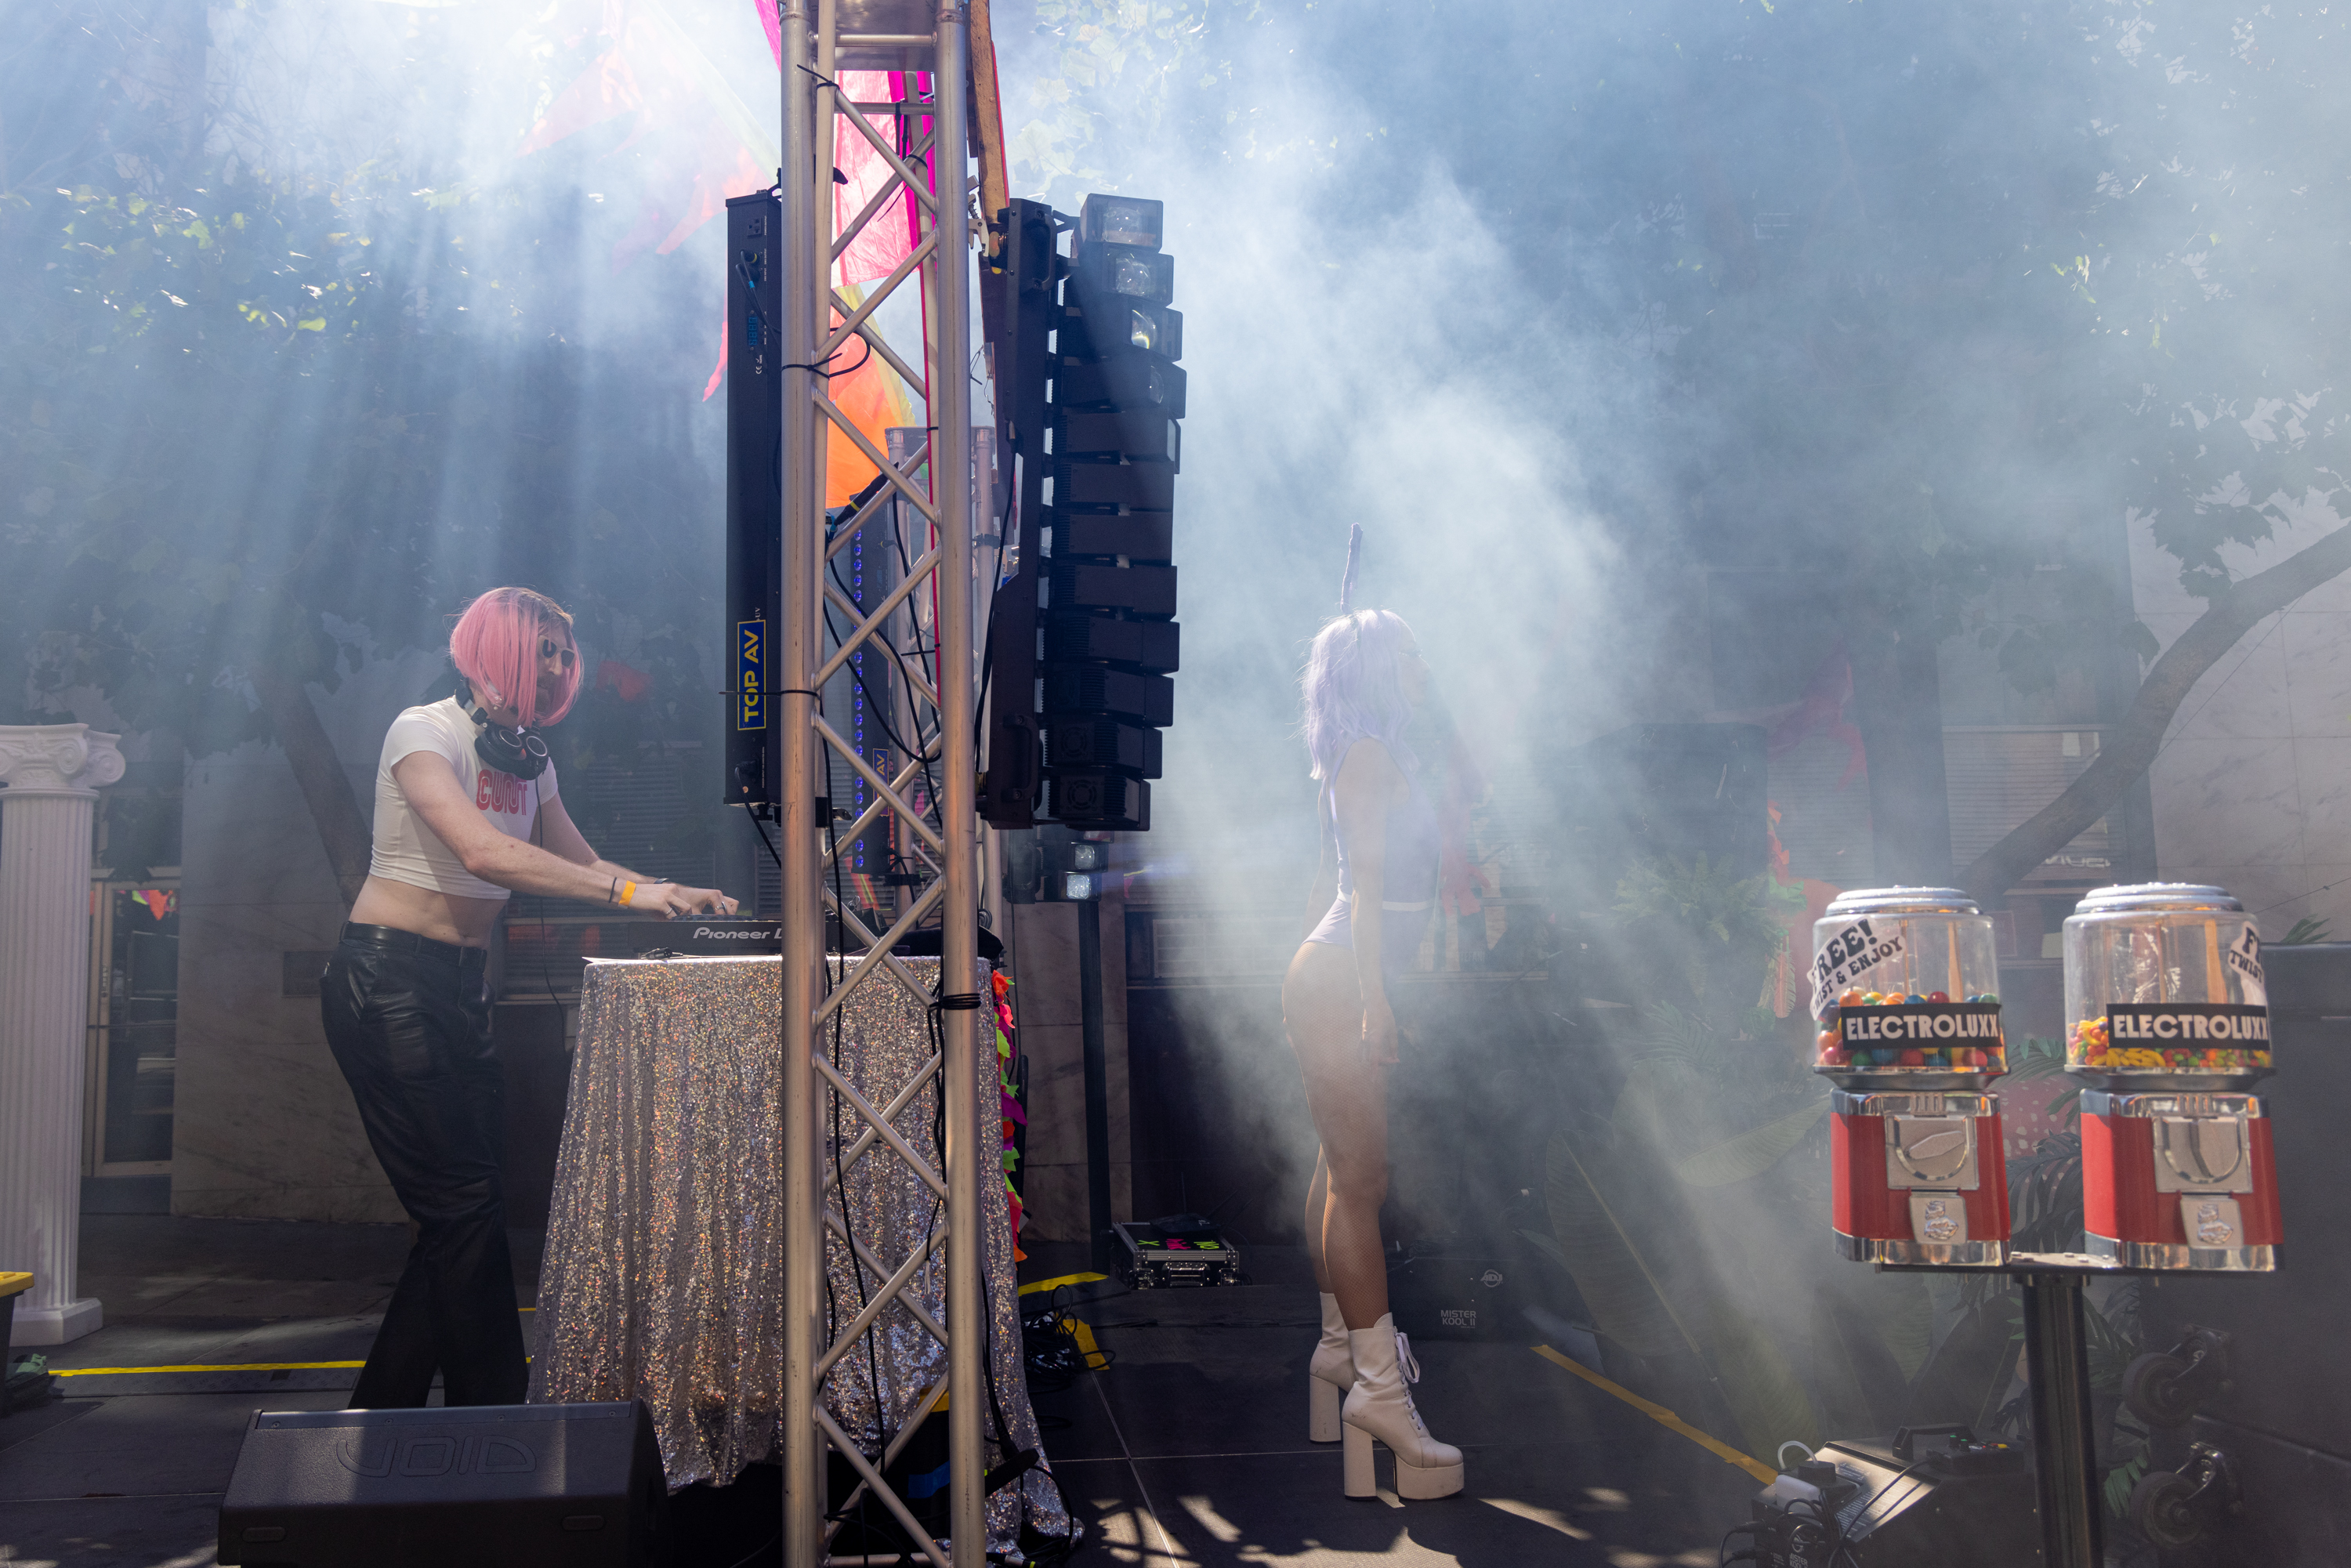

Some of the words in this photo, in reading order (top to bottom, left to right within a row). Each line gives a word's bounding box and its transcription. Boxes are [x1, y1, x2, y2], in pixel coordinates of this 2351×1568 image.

[744, 629, 759, 664] AV
[744, 670, 759, 722] TOP
[876, 753, 886, 776] AV
[476, 769, 527, 816] CUNT
[693, 926, 770, 940] Pioneer
[1836, 970, 1847, 985] &
[1848, 936, 1903, 976] ENJOY
[2230, 949, 2263, 983] TWIST
[1846, 1014, 1999, 1041] ELECTROLUXX
[2113, 1014, 2269, 1041] ELECTROLUXX
[1480, 1273, 1503, 1282] ADJ
[1440, 1309, 1476, 1318] MISTER
[1442, 1317, 1467, 1326] KOOL
[336, 1434, 538, 1478] VOID
